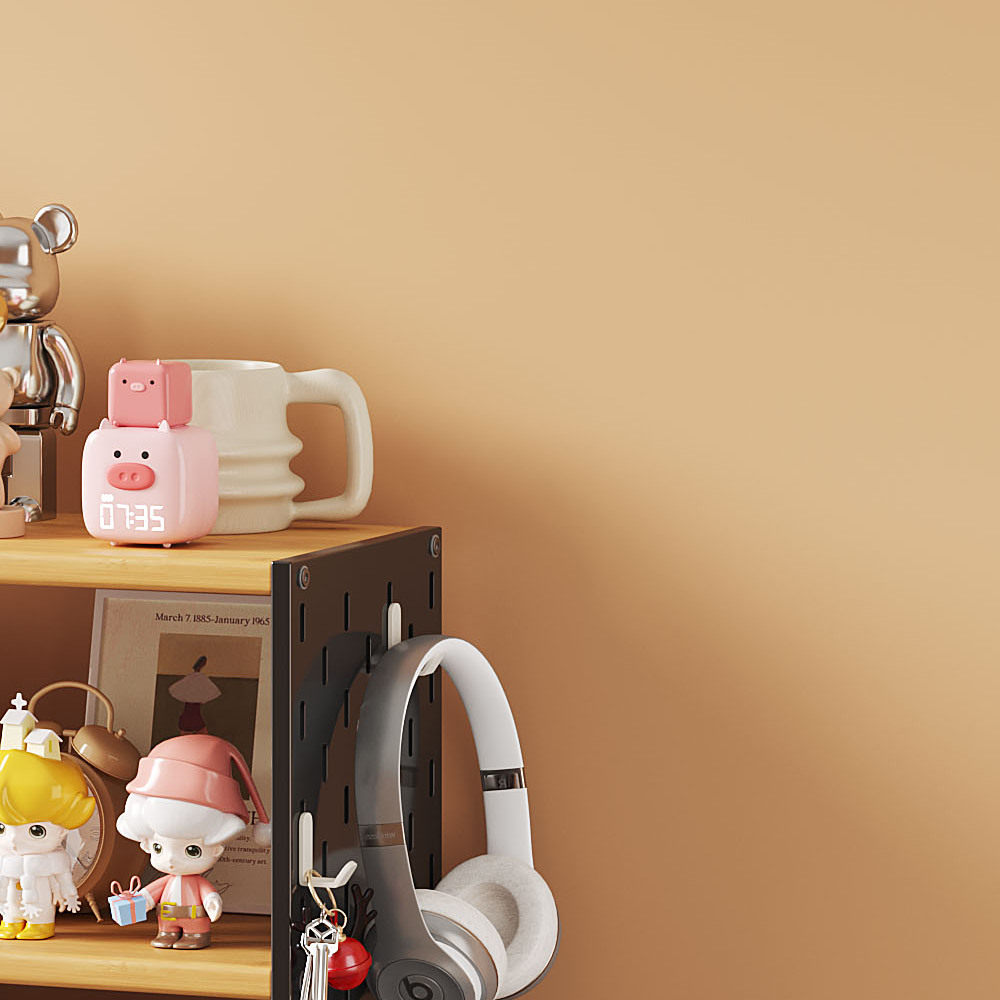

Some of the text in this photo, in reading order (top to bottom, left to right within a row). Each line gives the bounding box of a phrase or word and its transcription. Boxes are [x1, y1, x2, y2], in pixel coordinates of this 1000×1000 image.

[100, 503, 165, 532] 07:35
[155, 612, 183, 622] March
[252, 616, 271, 626] 1965
